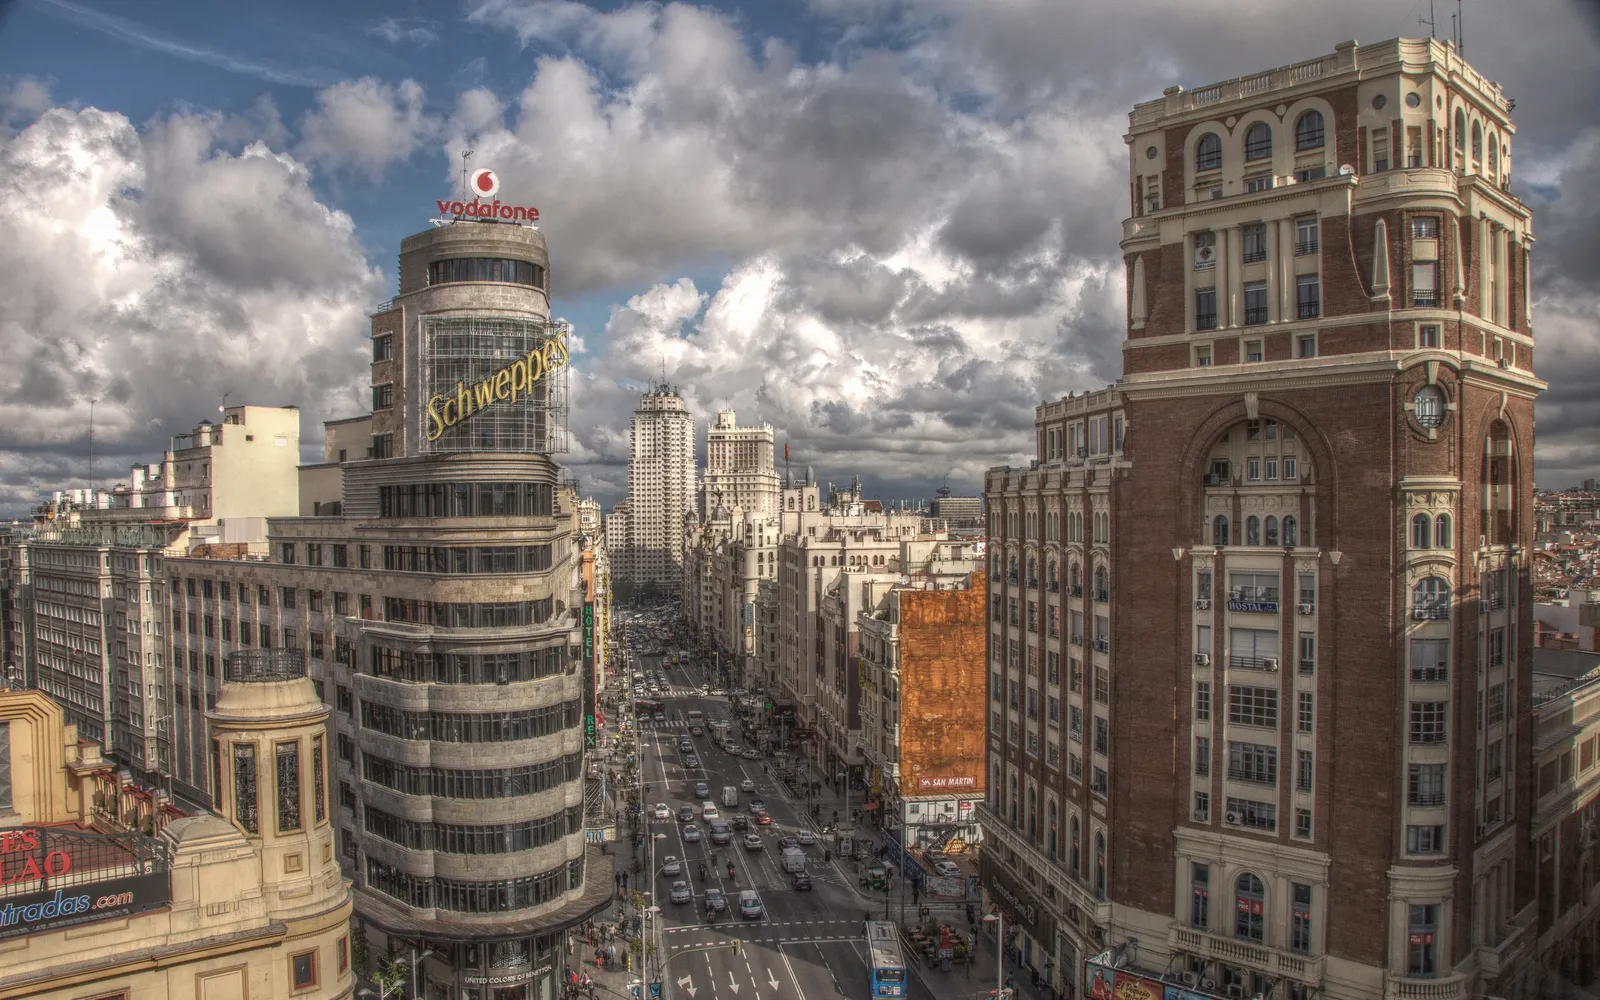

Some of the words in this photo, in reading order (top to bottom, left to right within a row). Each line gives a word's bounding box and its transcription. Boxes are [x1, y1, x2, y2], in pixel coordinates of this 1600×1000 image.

[437, 198, 539, 221] vodafone
[427, 331, 568, 441] Schweppes
[1229, 602, 1263, 611] HOSTAL
[585, 606, 593, 658] HOTEL
[586, 715, 595, 746] REX
[932, 778, 946, 786] SAN
[948, 777, 974, 786] MARTIN
[464, 976, 488, 984] UNITED
[489, 975, 516, 984] COLORS
[525, 964, 552, 979] BENETTON
[1116, 982, 1125, 991] El
